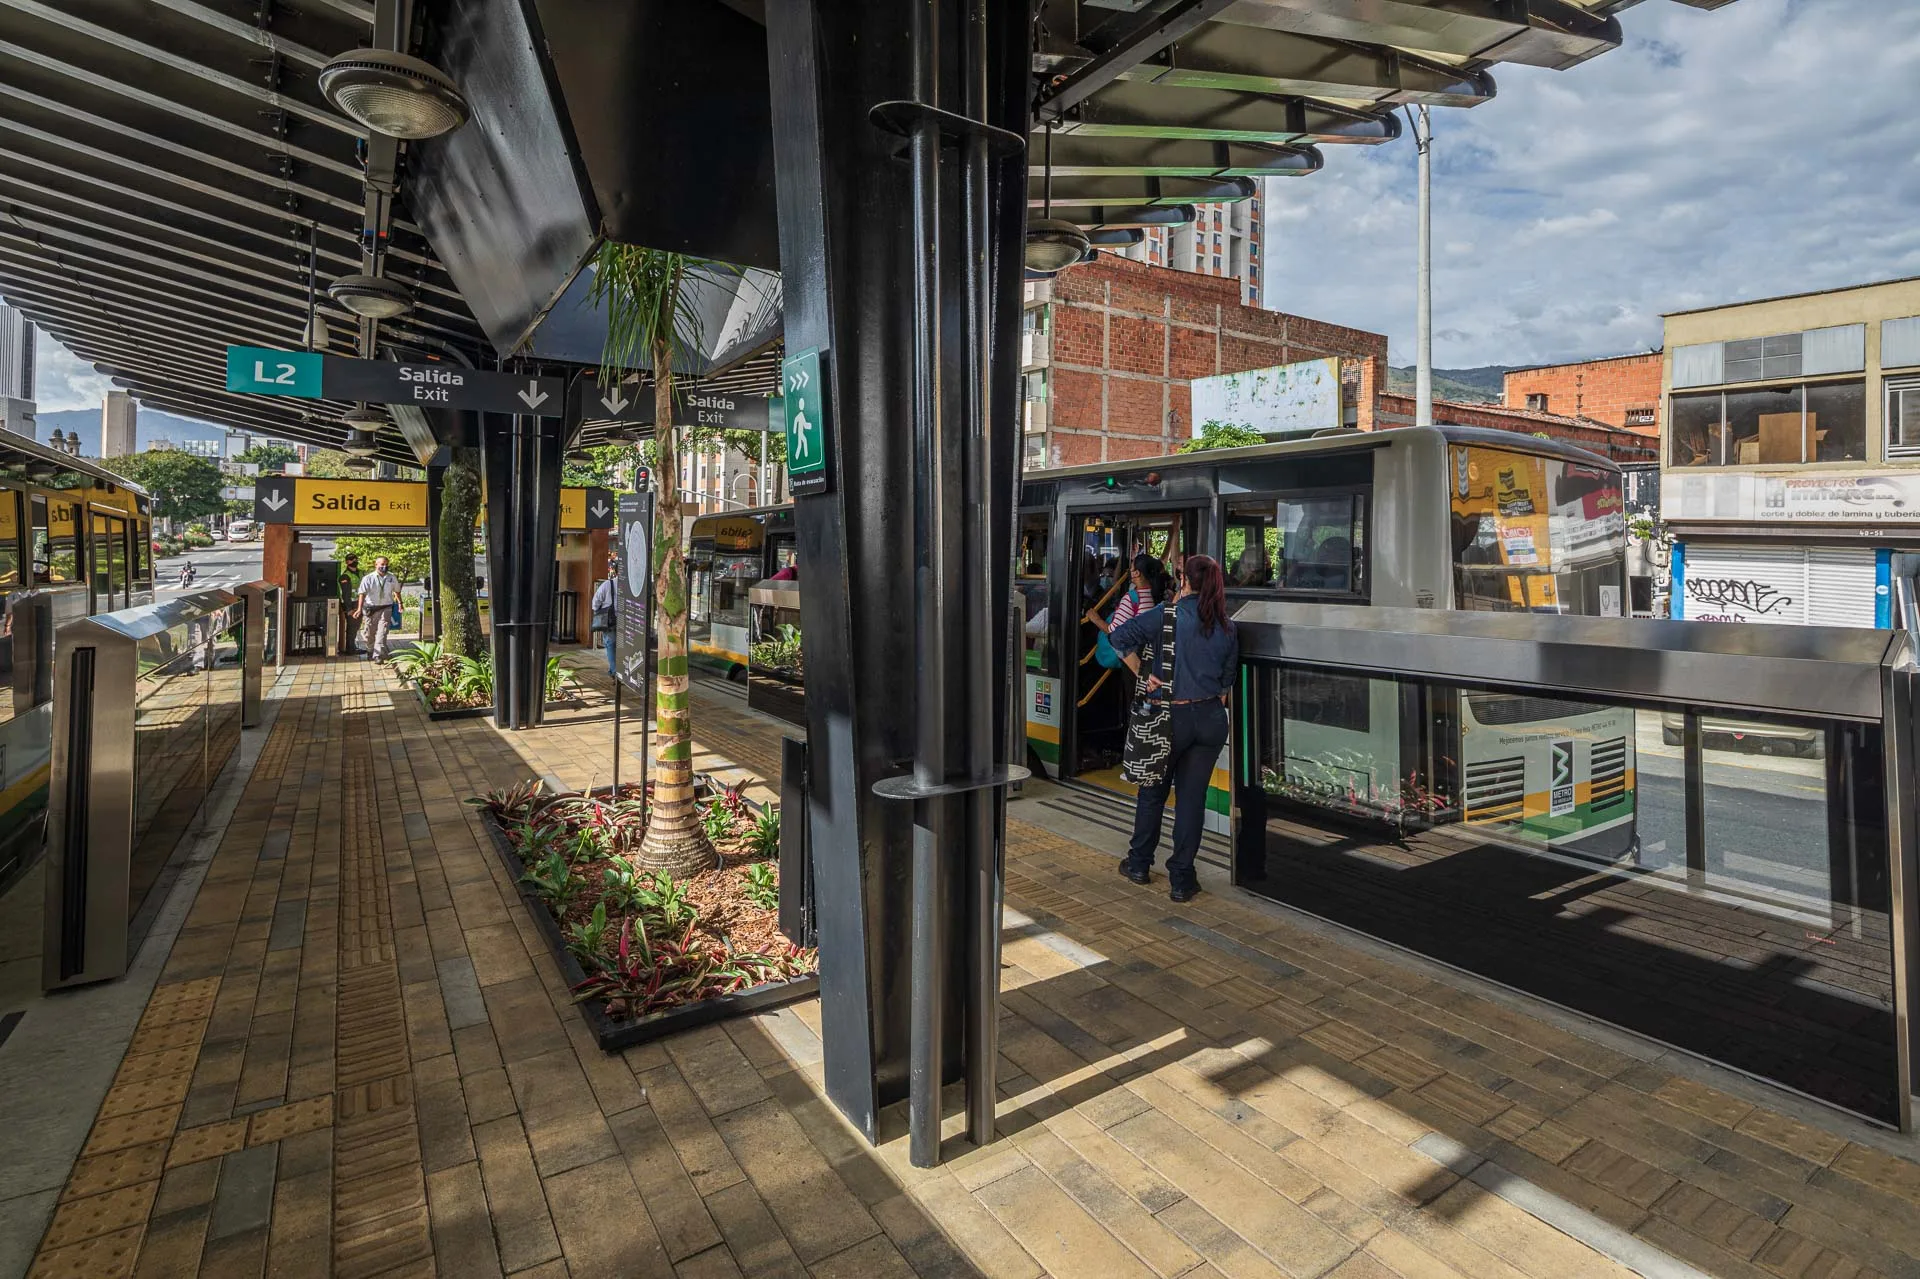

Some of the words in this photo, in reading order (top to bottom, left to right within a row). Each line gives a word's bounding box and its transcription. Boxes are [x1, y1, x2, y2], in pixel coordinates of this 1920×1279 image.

[254, 360, 296, 385] L2
[399, 366, 464, 386] Salida
[414, 385, 449, 402] Exit
[687, 394, 735, 410] Salida
[698, 410, 724, 424] Exit
[1786, 479, 1856, 488] PROYECTOS
[312, 493, 381, 511] Salida
[389, 501, 411, 511] Exit
[1761, 510, 1785, 518] corte
[1795, 509, 1825, 517] doblez
[1875, 511, 1882, 519] y
[1553, 787, 1572, 799] METRO
